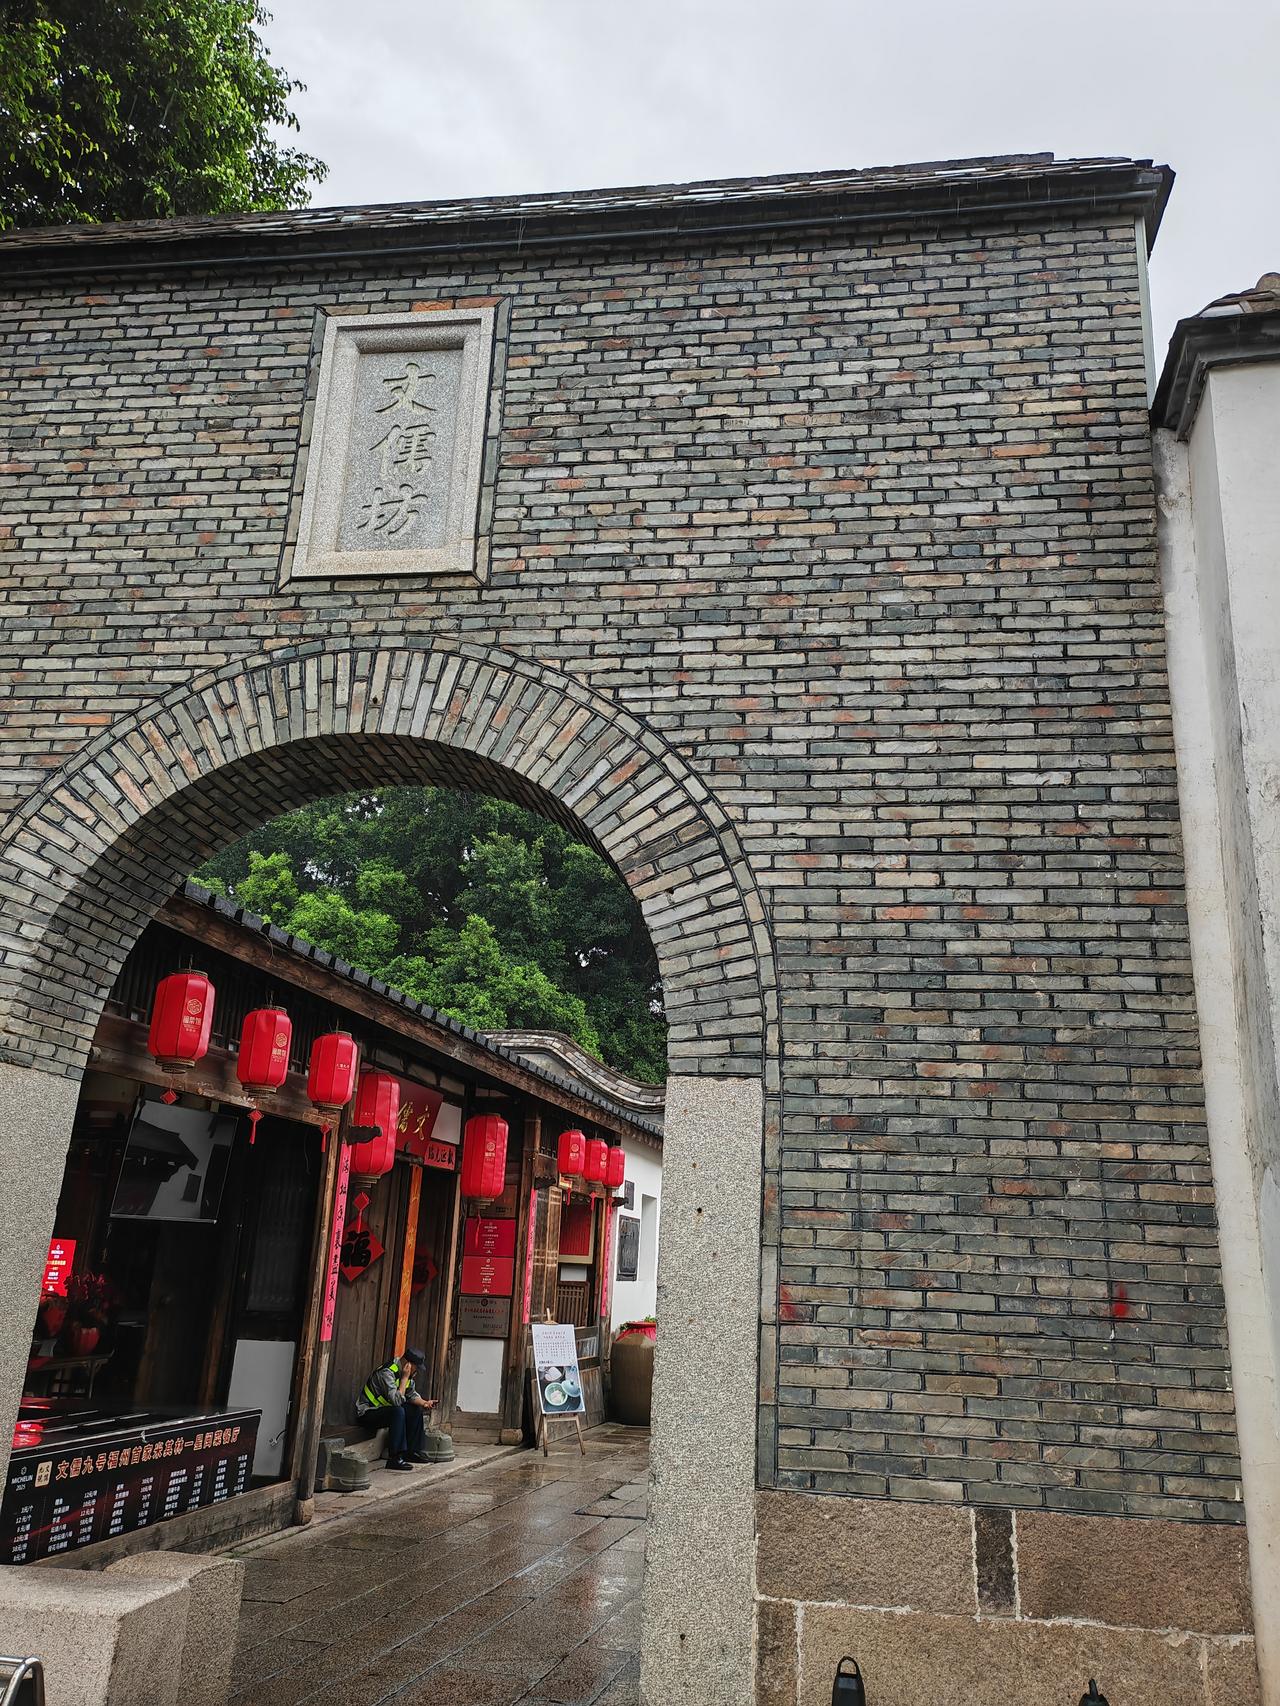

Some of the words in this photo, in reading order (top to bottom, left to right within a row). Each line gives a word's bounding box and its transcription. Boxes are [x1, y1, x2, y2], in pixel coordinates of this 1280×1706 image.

[356, 362, 437, 536] 文儒坊
[340, 1230, 371, 1268] 福
[11, 1475, 33, 1485] MICHELIN
